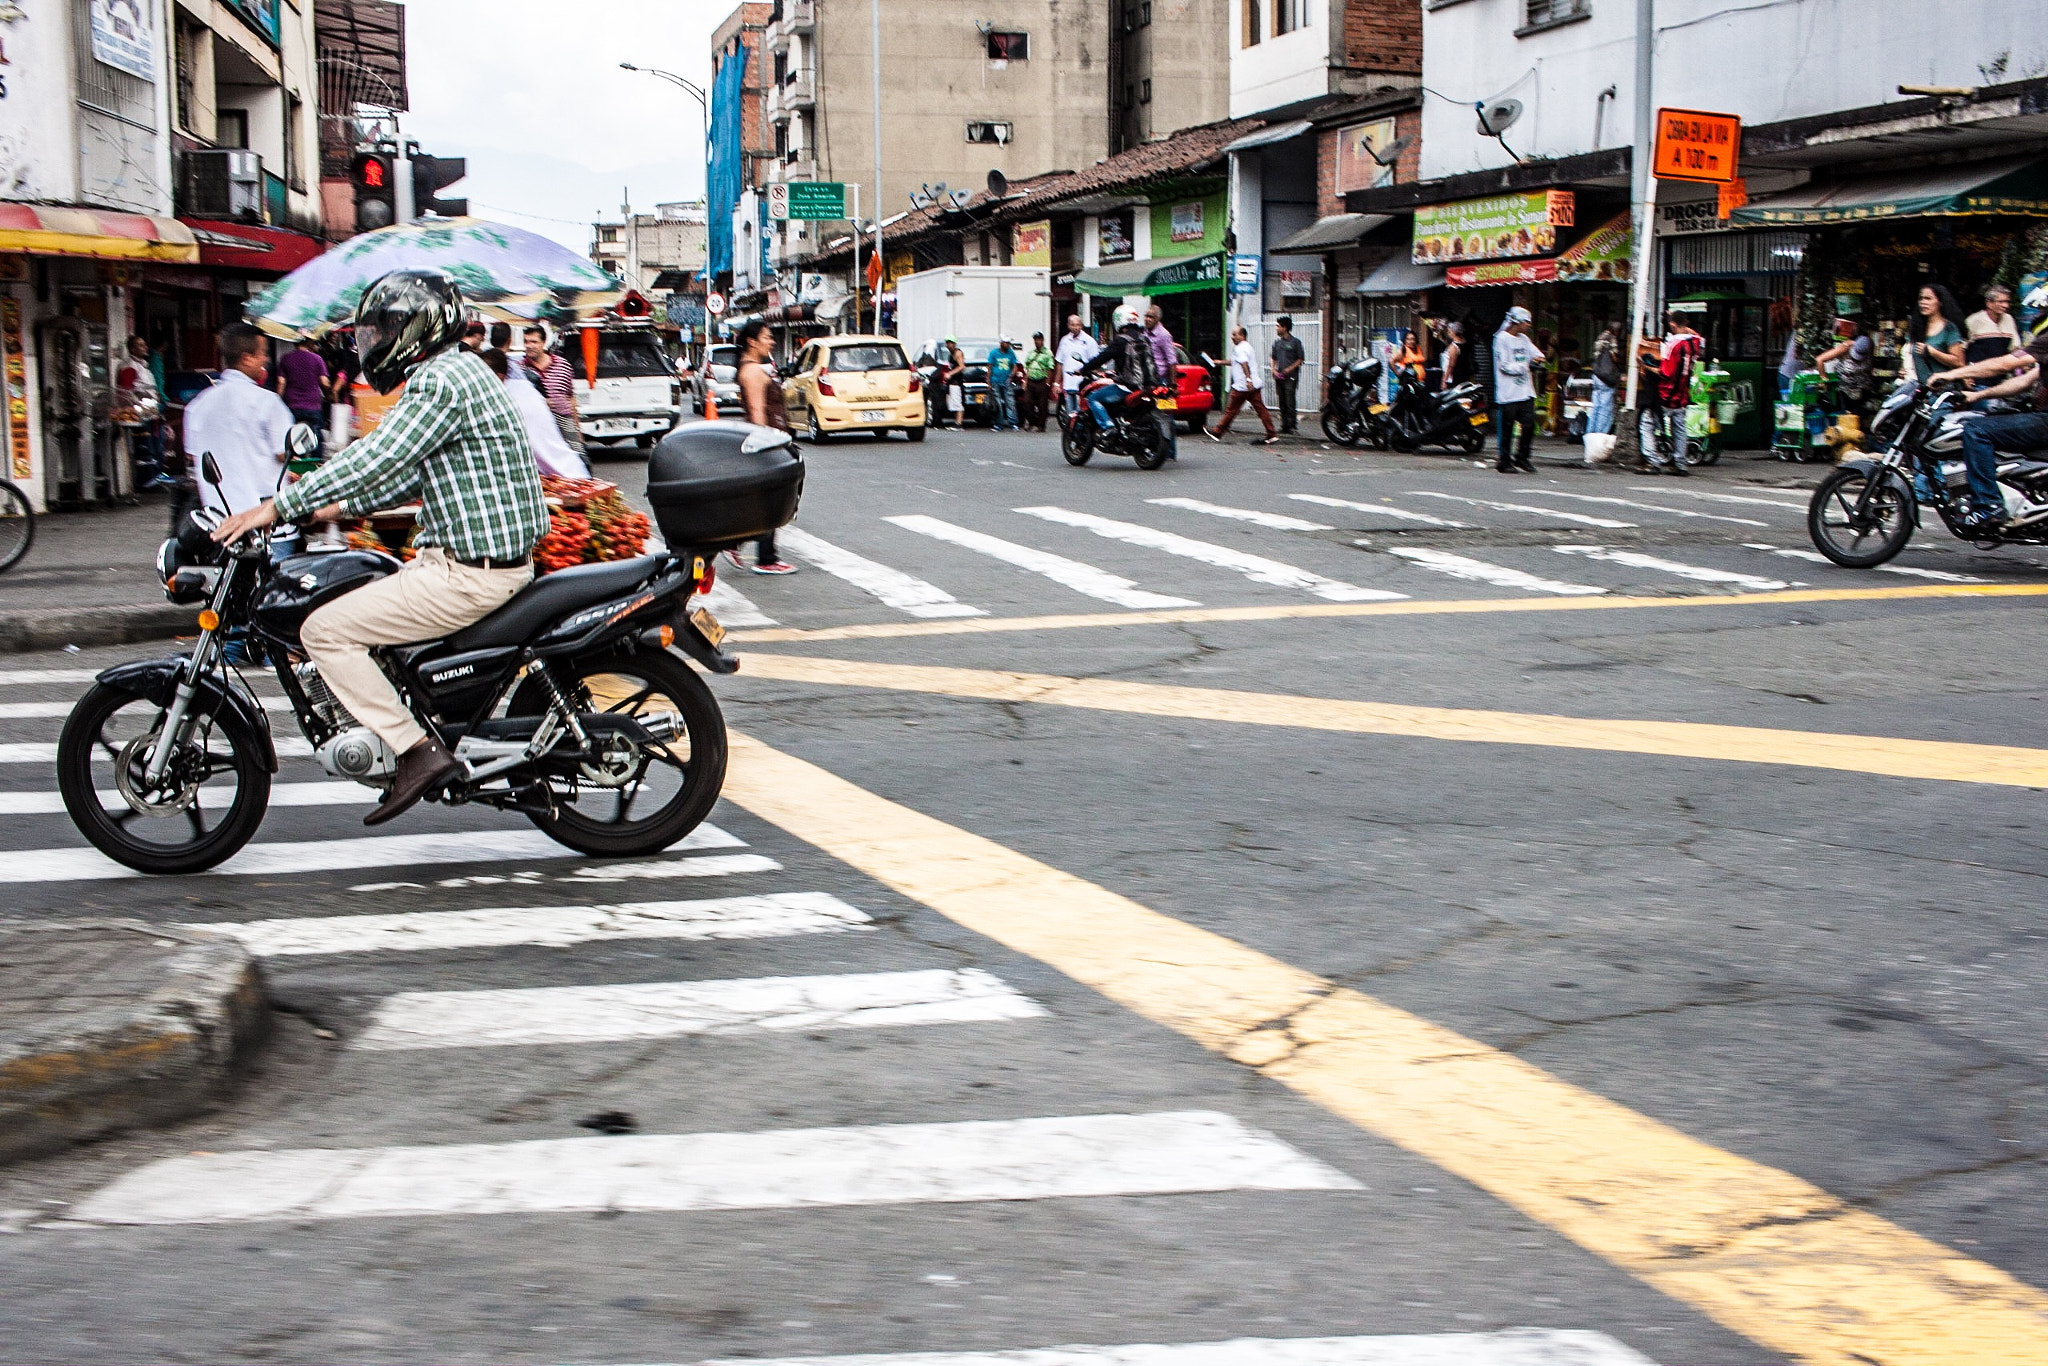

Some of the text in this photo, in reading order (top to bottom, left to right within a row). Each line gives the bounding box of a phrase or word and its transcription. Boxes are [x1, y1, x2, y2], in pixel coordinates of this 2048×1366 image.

[1671, 147, 1719, 171] A 100 m
[1438, 194, 1528, 218] BIENVENIDOS
[1475, 263, 1521, 281] RESTAURANTE
[432, 664, 475, 683] SUZUKI
